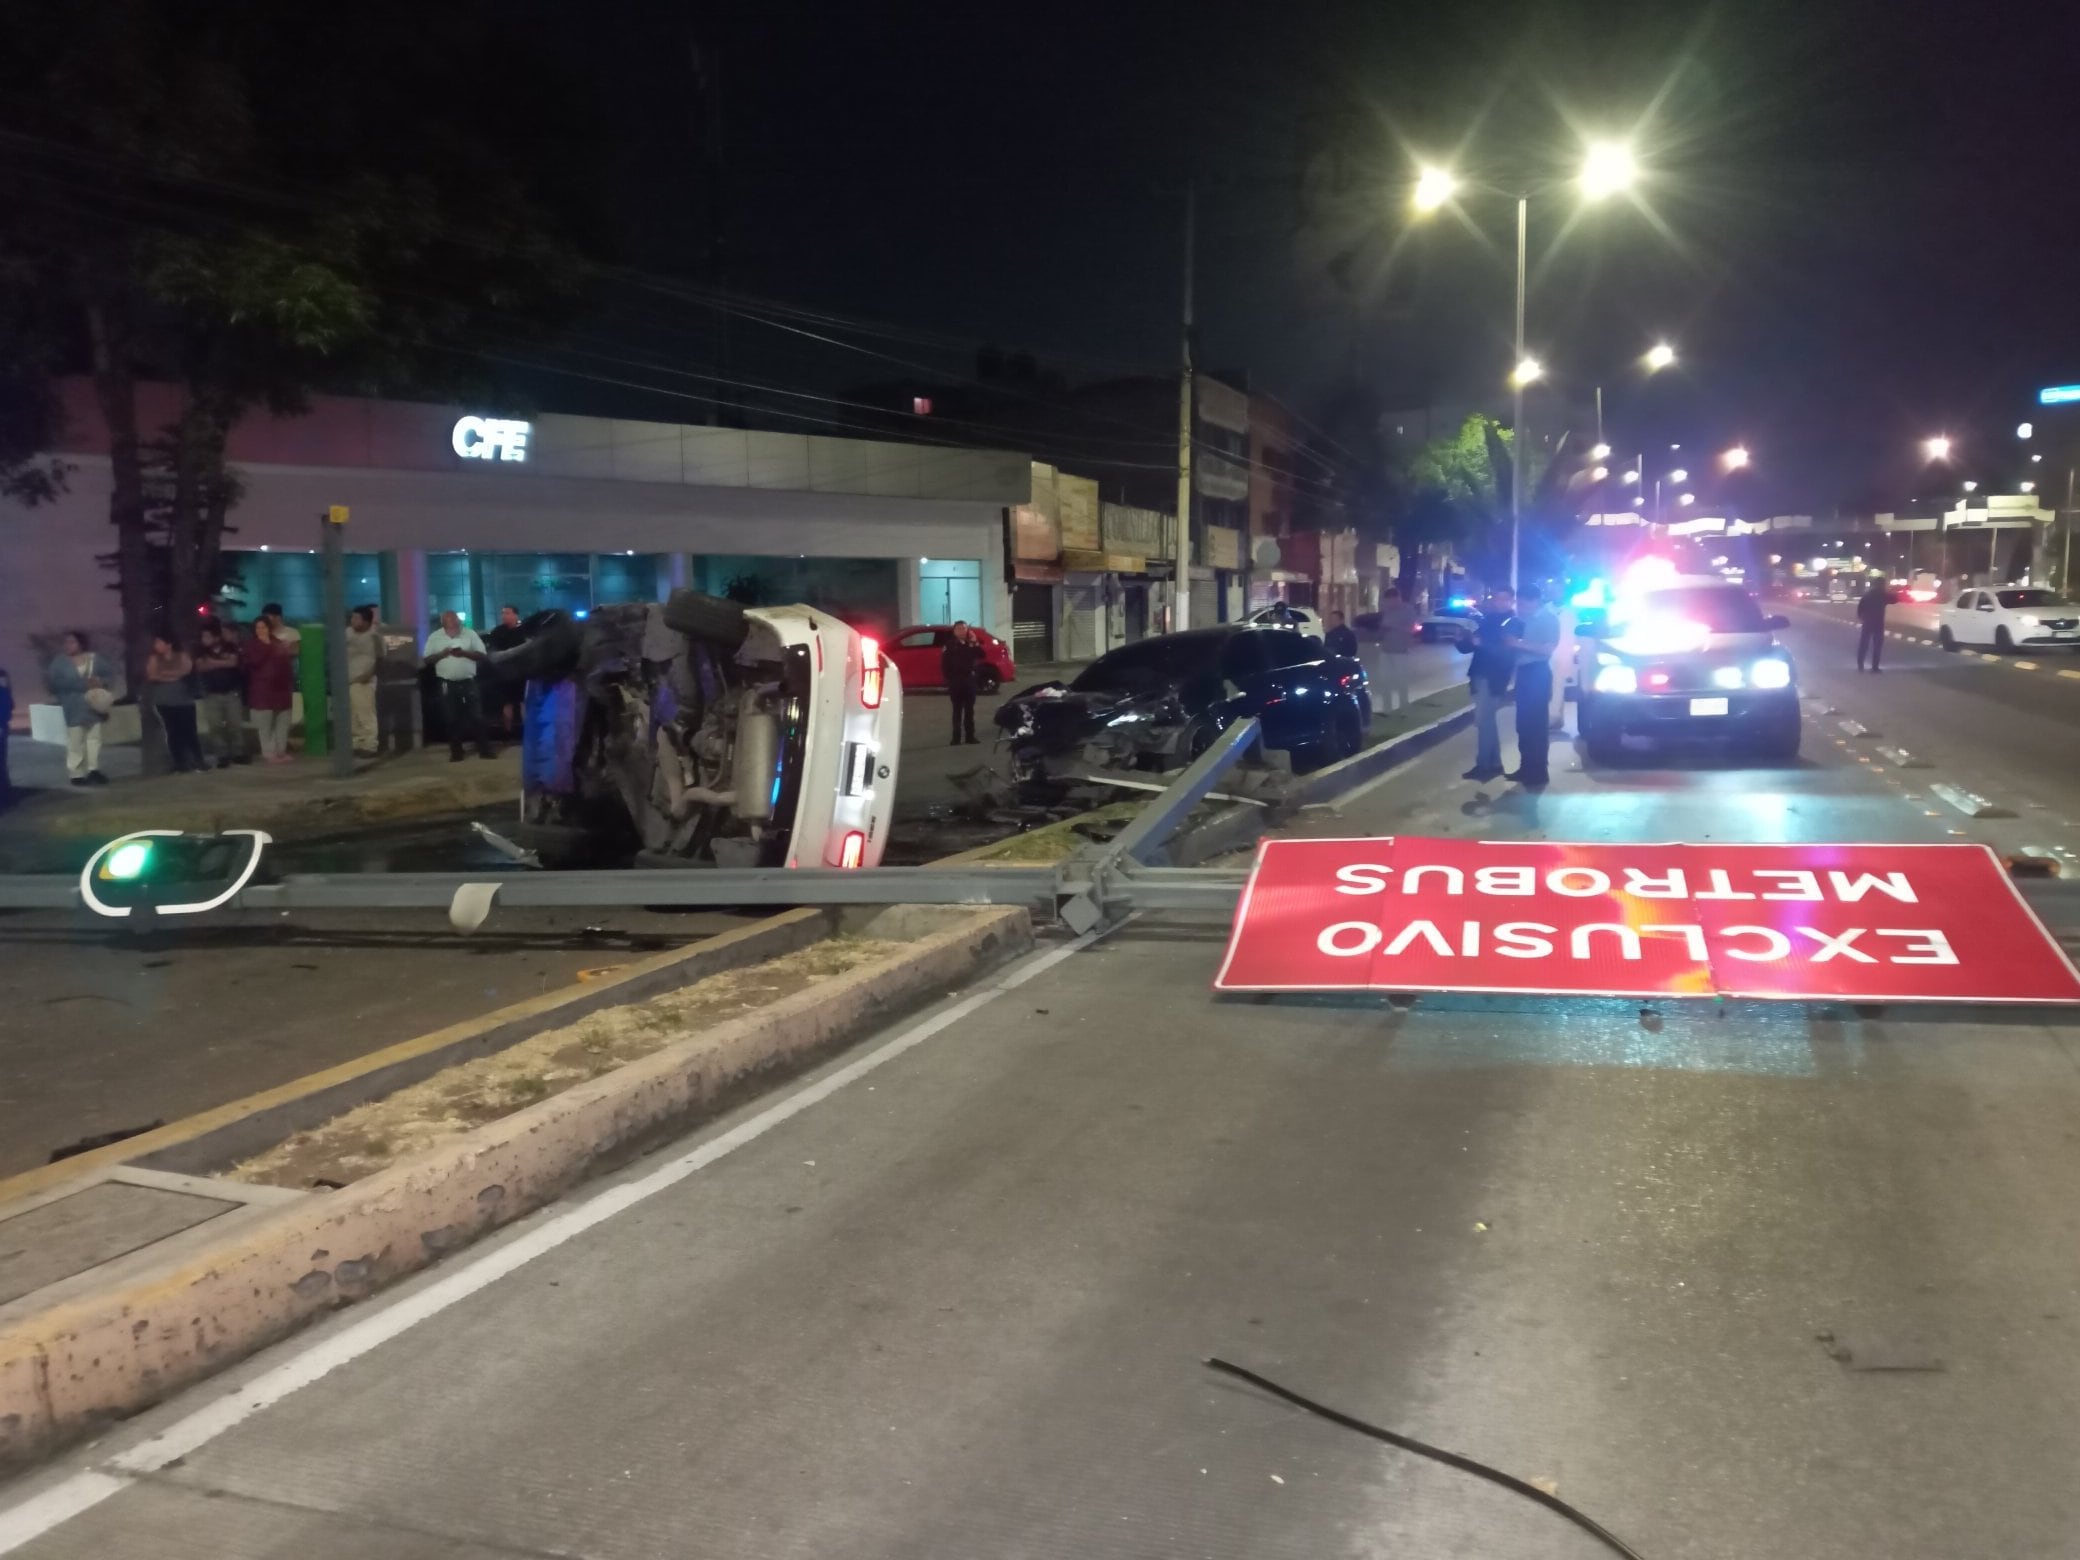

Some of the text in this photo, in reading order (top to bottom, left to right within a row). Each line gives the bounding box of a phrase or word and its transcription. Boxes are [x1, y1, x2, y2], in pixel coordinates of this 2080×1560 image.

[452, 416, 530, 461] CFE
[1334, 863, 1919, 903] METROBUS
[1316, 919, 1960, 965] EXCLUSIVO
